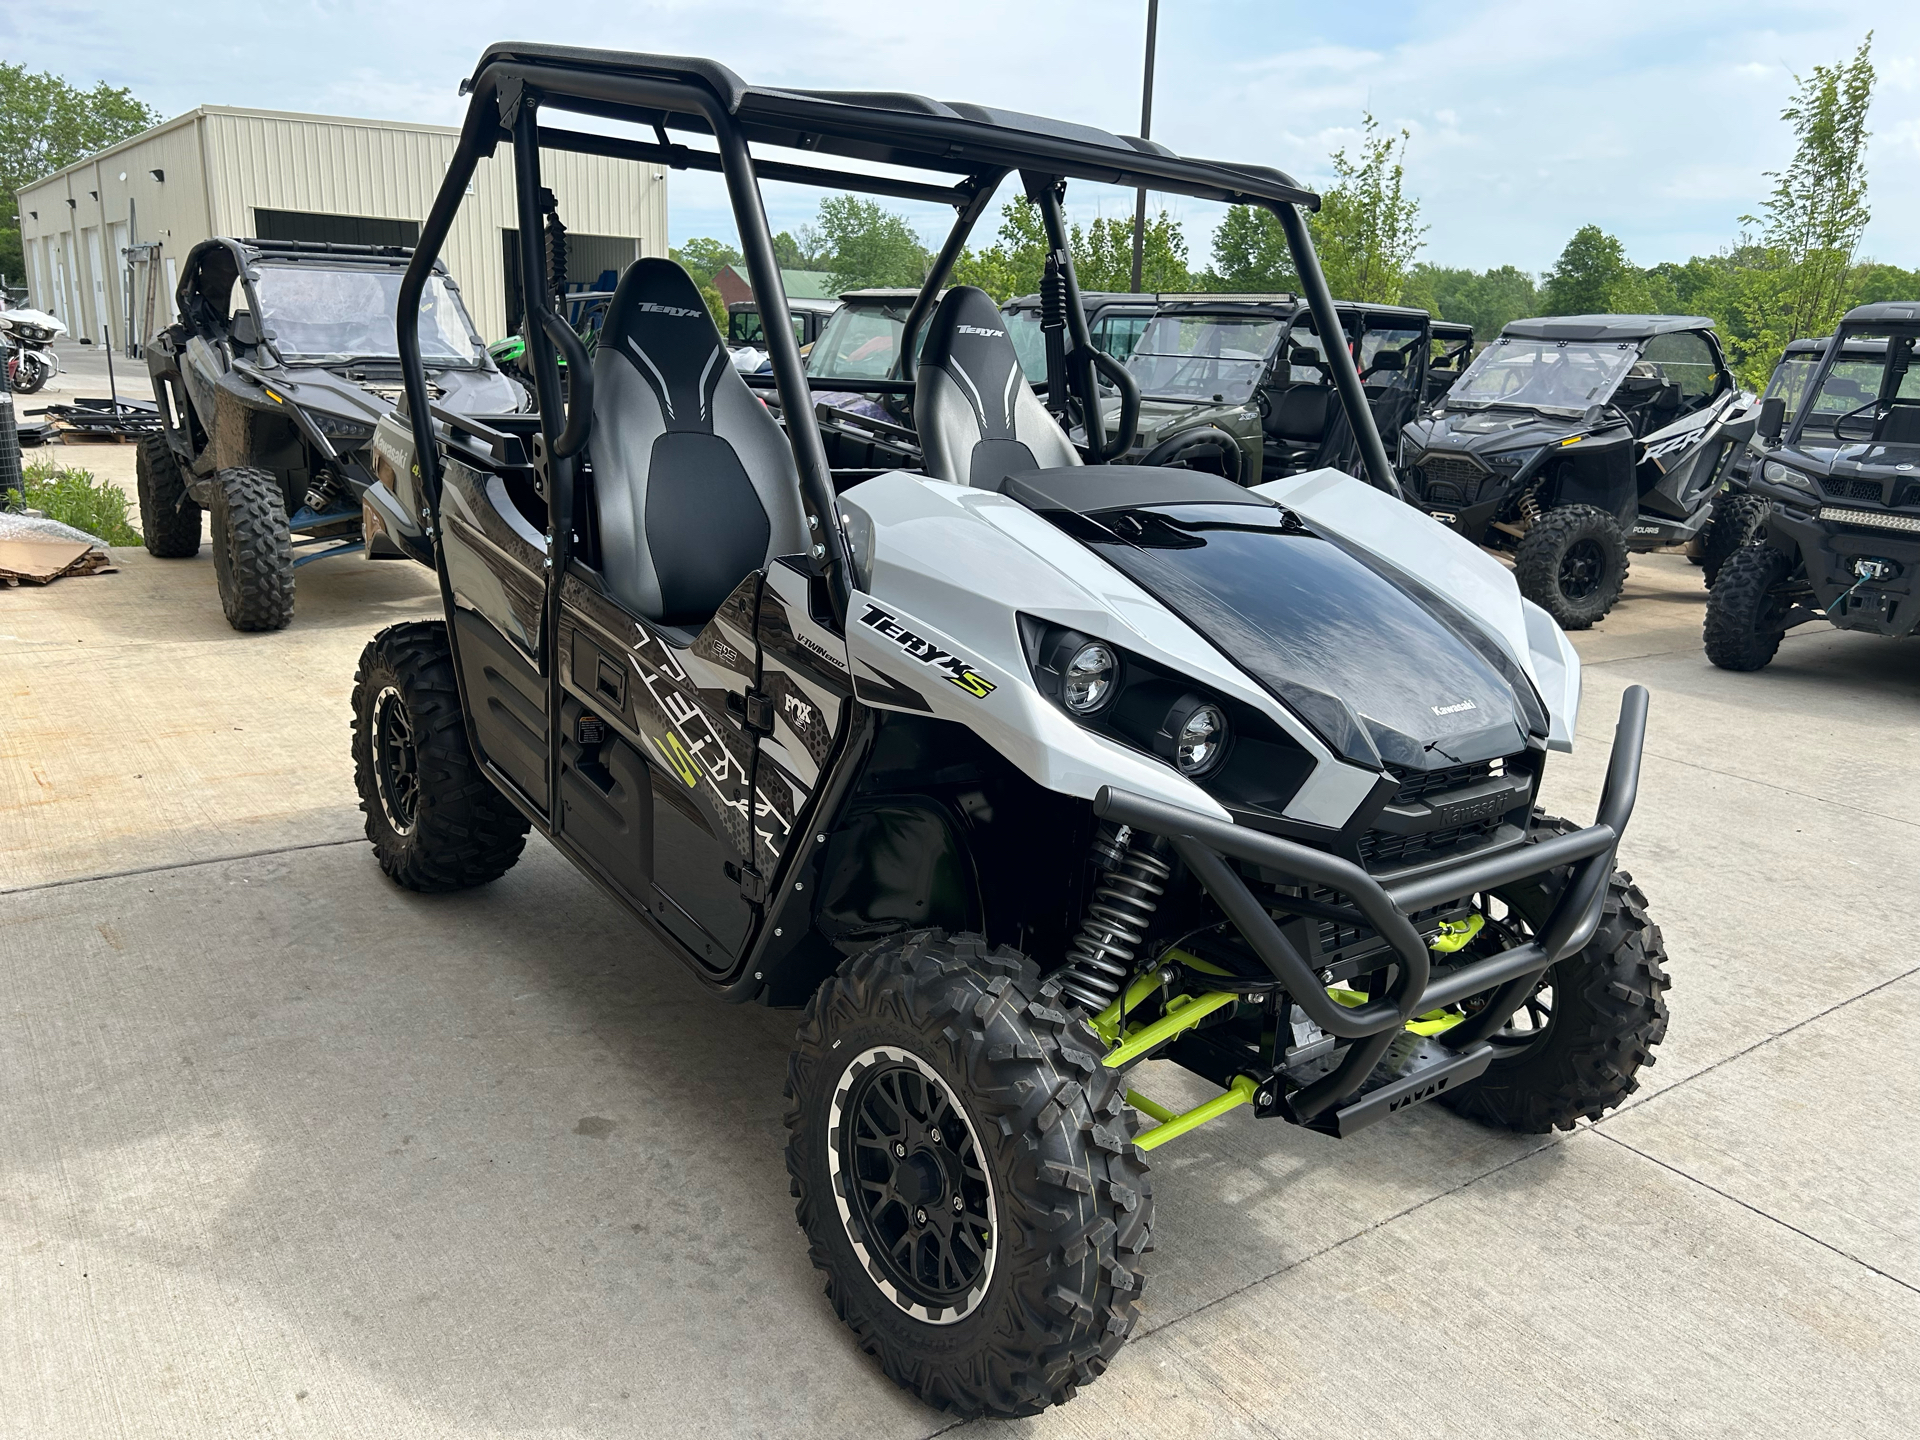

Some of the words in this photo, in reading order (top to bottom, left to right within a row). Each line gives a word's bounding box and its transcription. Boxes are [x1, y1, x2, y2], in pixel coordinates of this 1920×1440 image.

[373, 430, 408, 470] Kawasaki
[1635, 427, 1706, 467] RZR
[1632, 526, 1660, 535] POLARIS
[784, 693, 813, 725] FOX
[1430, 699, 1477, 717] Kawasaki
[1439, 792, 1509, 827] Kawasaki
